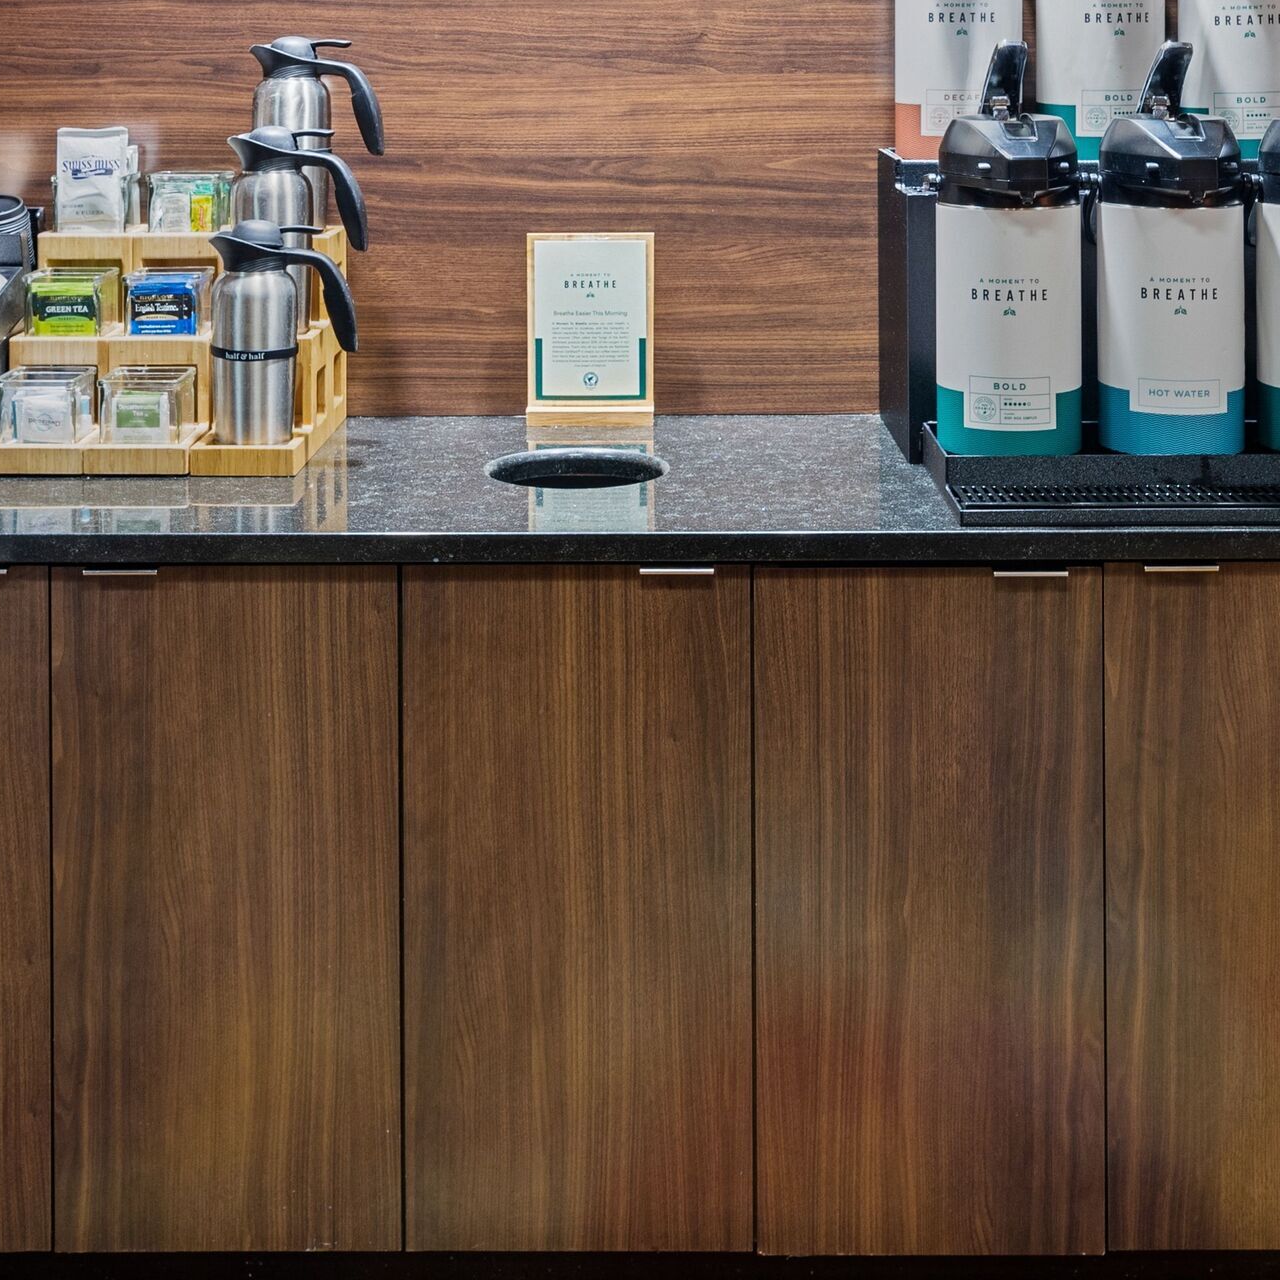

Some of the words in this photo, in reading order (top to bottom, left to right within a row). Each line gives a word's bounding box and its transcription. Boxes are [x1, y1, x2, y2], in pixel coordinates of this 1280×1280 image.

[928, 12, 995, 23] BREATHE
[1084, 11, 1150, 24] BREATHE
[1104, 94, 1133, 102] BOLD
[1236, 96, 1267, 104] BOLD
[564, 280, 617, 289] BREATHE
[971, 288, 1048, 302] BREATHE
[1140, 287, 1218, 301] BREATHE
[45, 305, 71, 313] GREEN
[72, 305, 89, 313] TEA
[135, 303, 155, 313] English
[225, 351, 240, 360] half
[248, 352, 266, 360] half
[993, 382, 1027, 391] BOLD
[1148, 388, 1170, 397] HOT
[1173, 389, 1211, 398] WATER
